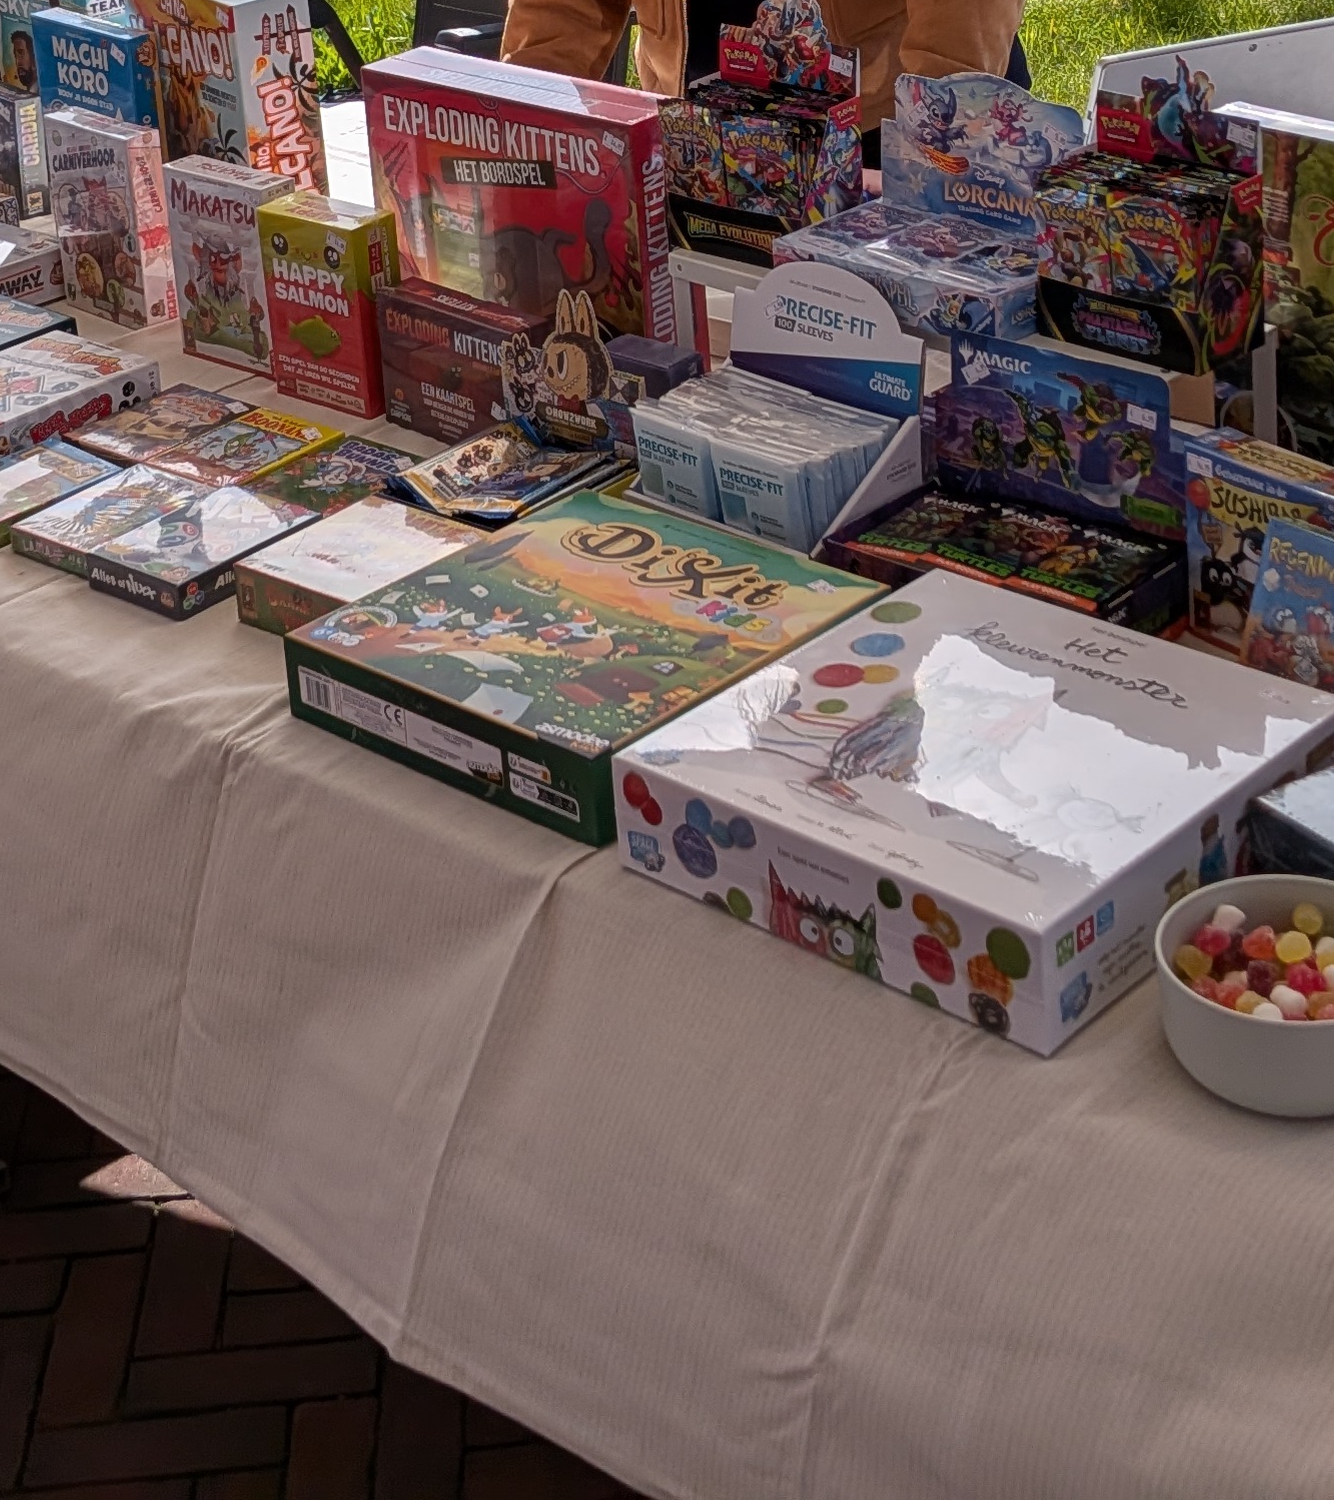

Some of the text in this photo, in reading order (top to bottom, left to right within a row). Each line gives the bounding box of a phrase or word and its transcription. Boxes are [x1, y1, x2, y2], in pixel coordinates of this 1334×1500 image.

[51, 35, 110, 73] MACHI
[56, 65, 110, 98] KORO
[19, 102, 41, 167] CARDIA
[258, 76, 315, 193] LCANO!
[382, 94, 602, 177] EXPLODING KITTENS
[52, 147, 116, 174] CARNIVERHOOR
[453, 159, 547, 186] HET BORDSPEL
[170, 177, 256, 229] MAKATSU
[641, 144, 670, 261] KITTENS
[943, 180, 1036, 217] LORCANA
[688, 211, 717, 237] MEGA
[272, 256, 346, 295] HAPPY
[274, 281, 350, 318] SALMON
[776, 295, 878, 341] PRECISE-FIT
[385, 307, 504, 367] EXPLODING KITTENS
[777, 317, 834, 343] 100 SLEEVES
[974, 348, 1033, 376] MAGIC
[420, 381, 435, 397] EEN
[435, 387, 476, 413] KAARTSPEL
[869, 379, 913, 402] GUARD
[638, 435, 698, 467] PRECISE-FIT
[719, 467, 784, 498] PRECISE-FIT
[91, 566, 117, 587] Alles
[214, 569, 236, 591] All
[579, 524, 786, 611] Dixit
[967, 620, 1191, 712] kleurenmonster
[1064, 632, 1129, 669] Het
